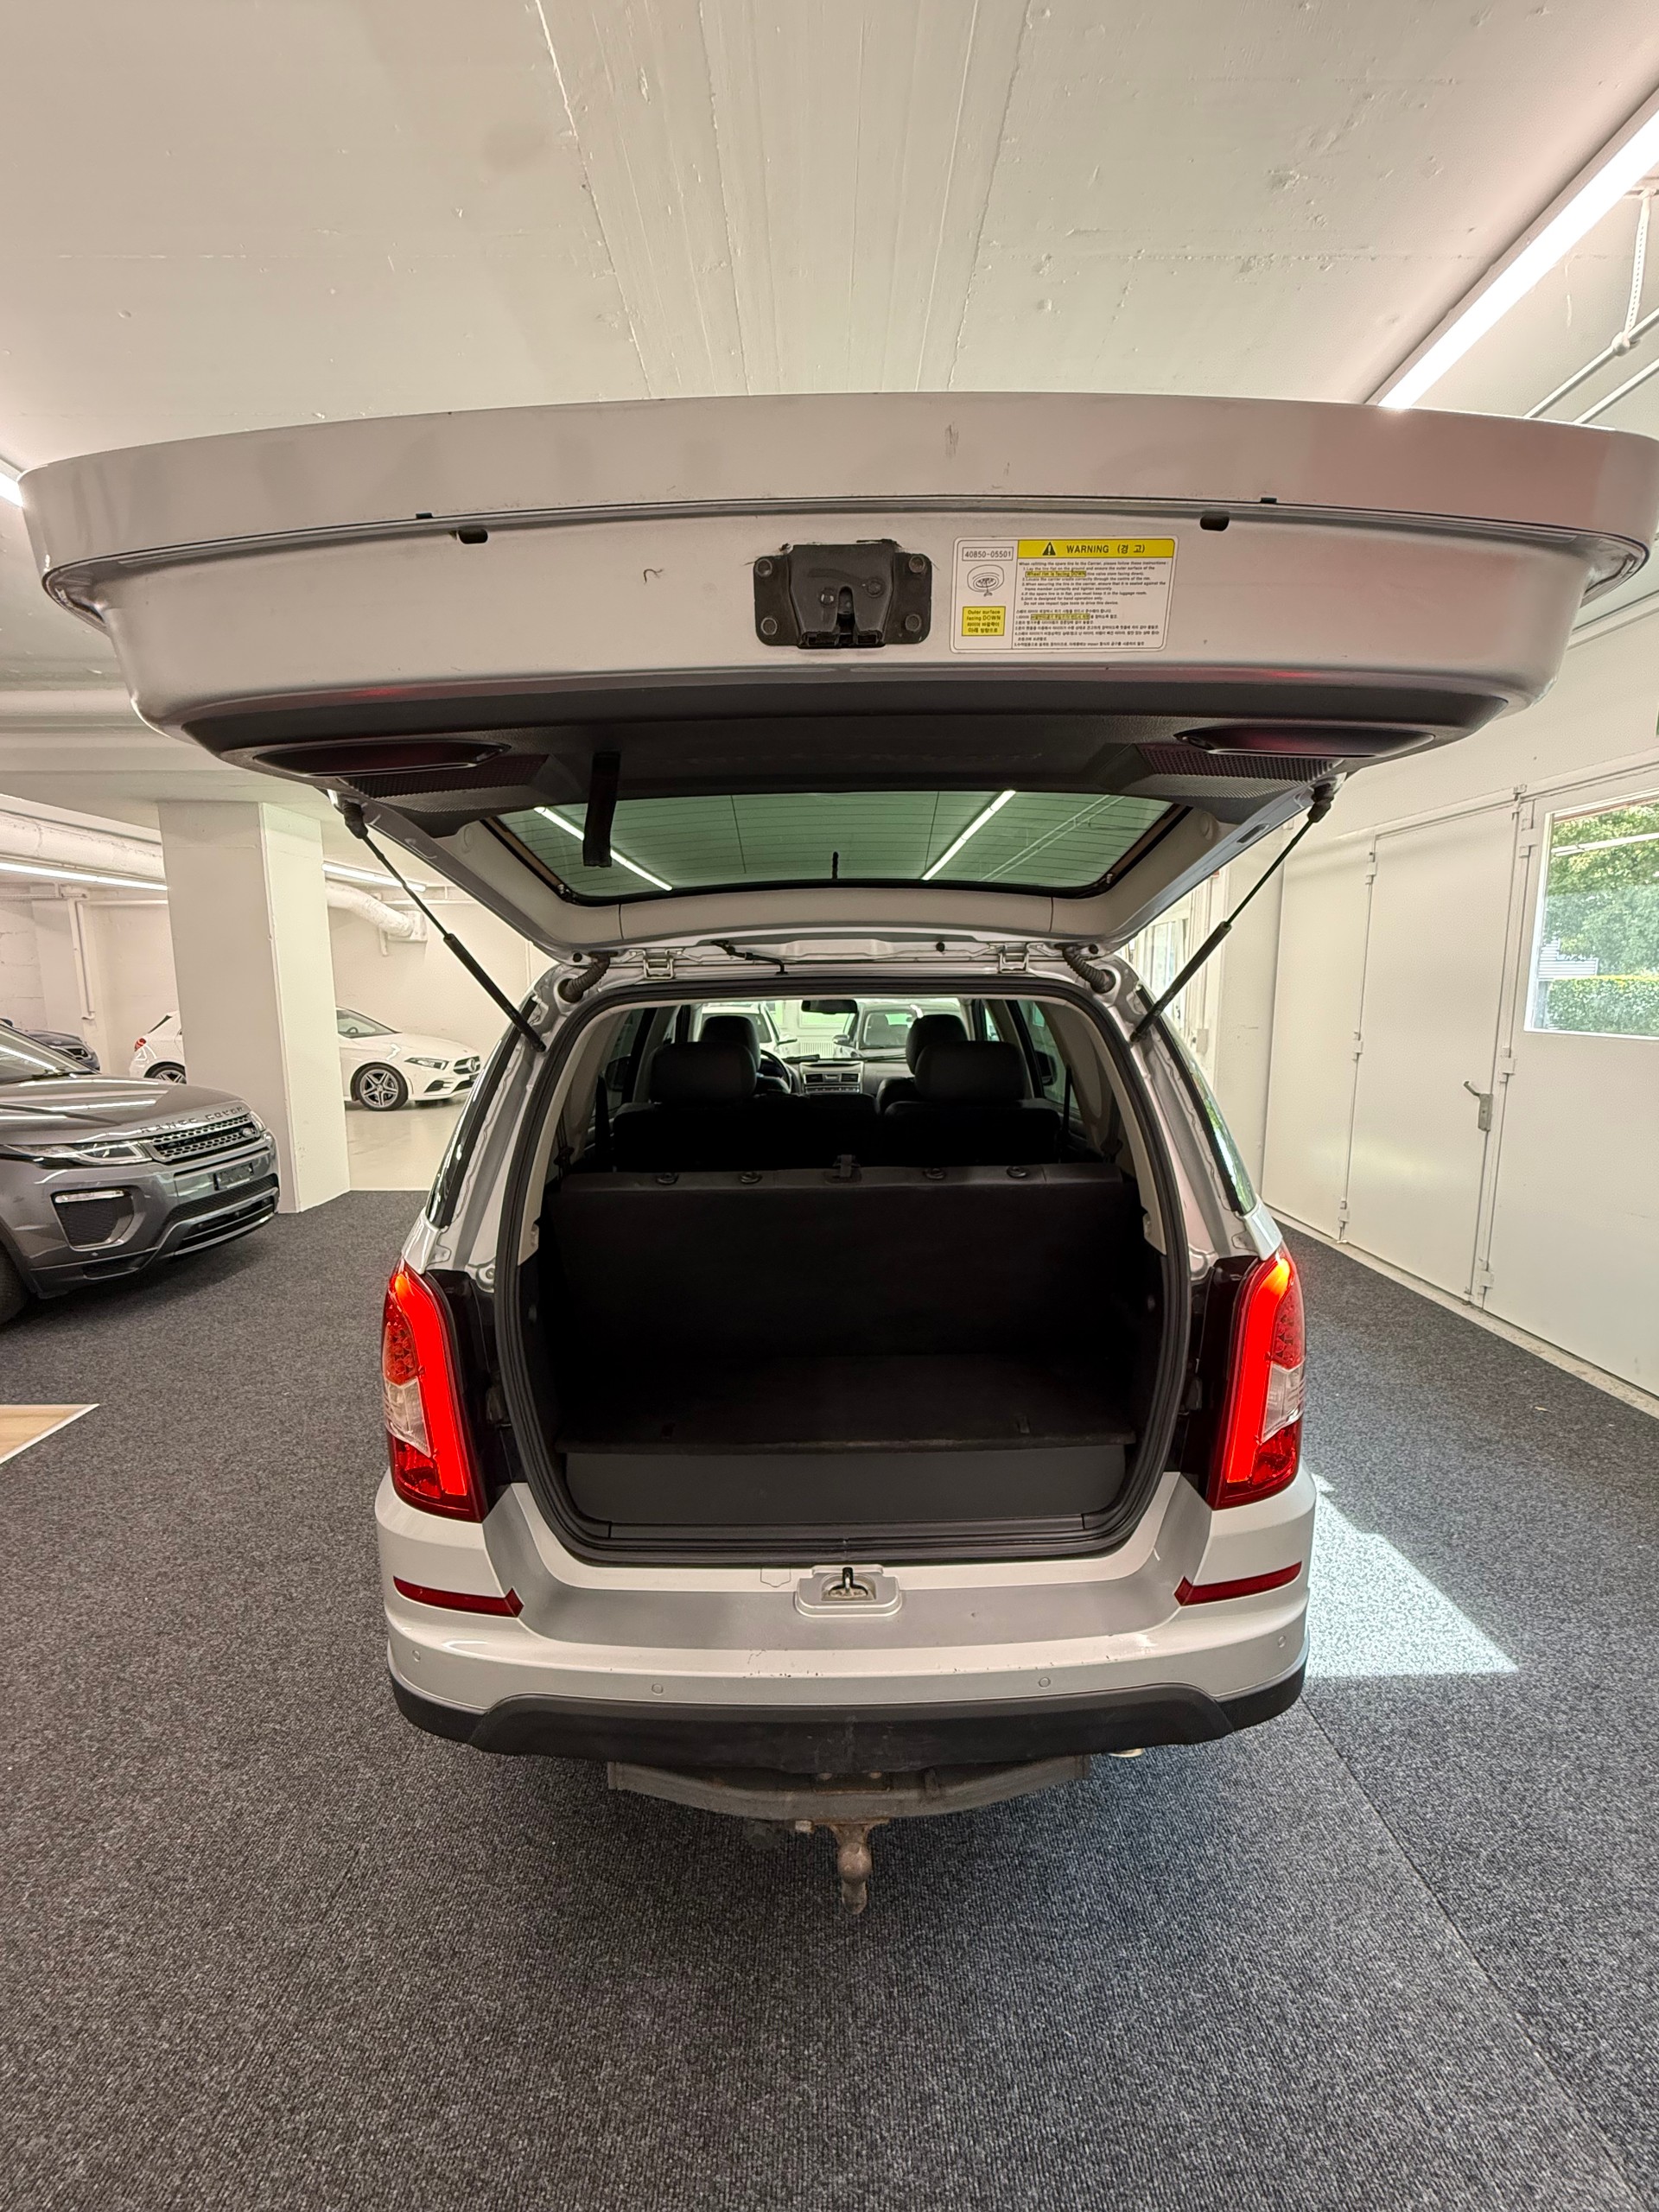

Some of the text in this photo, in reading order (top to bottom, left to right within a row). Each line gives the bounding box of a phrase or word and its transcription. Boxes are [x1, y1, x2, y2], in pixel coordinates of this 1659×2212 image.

[1066, 544, 1145, 555] WARNING (경 고)
